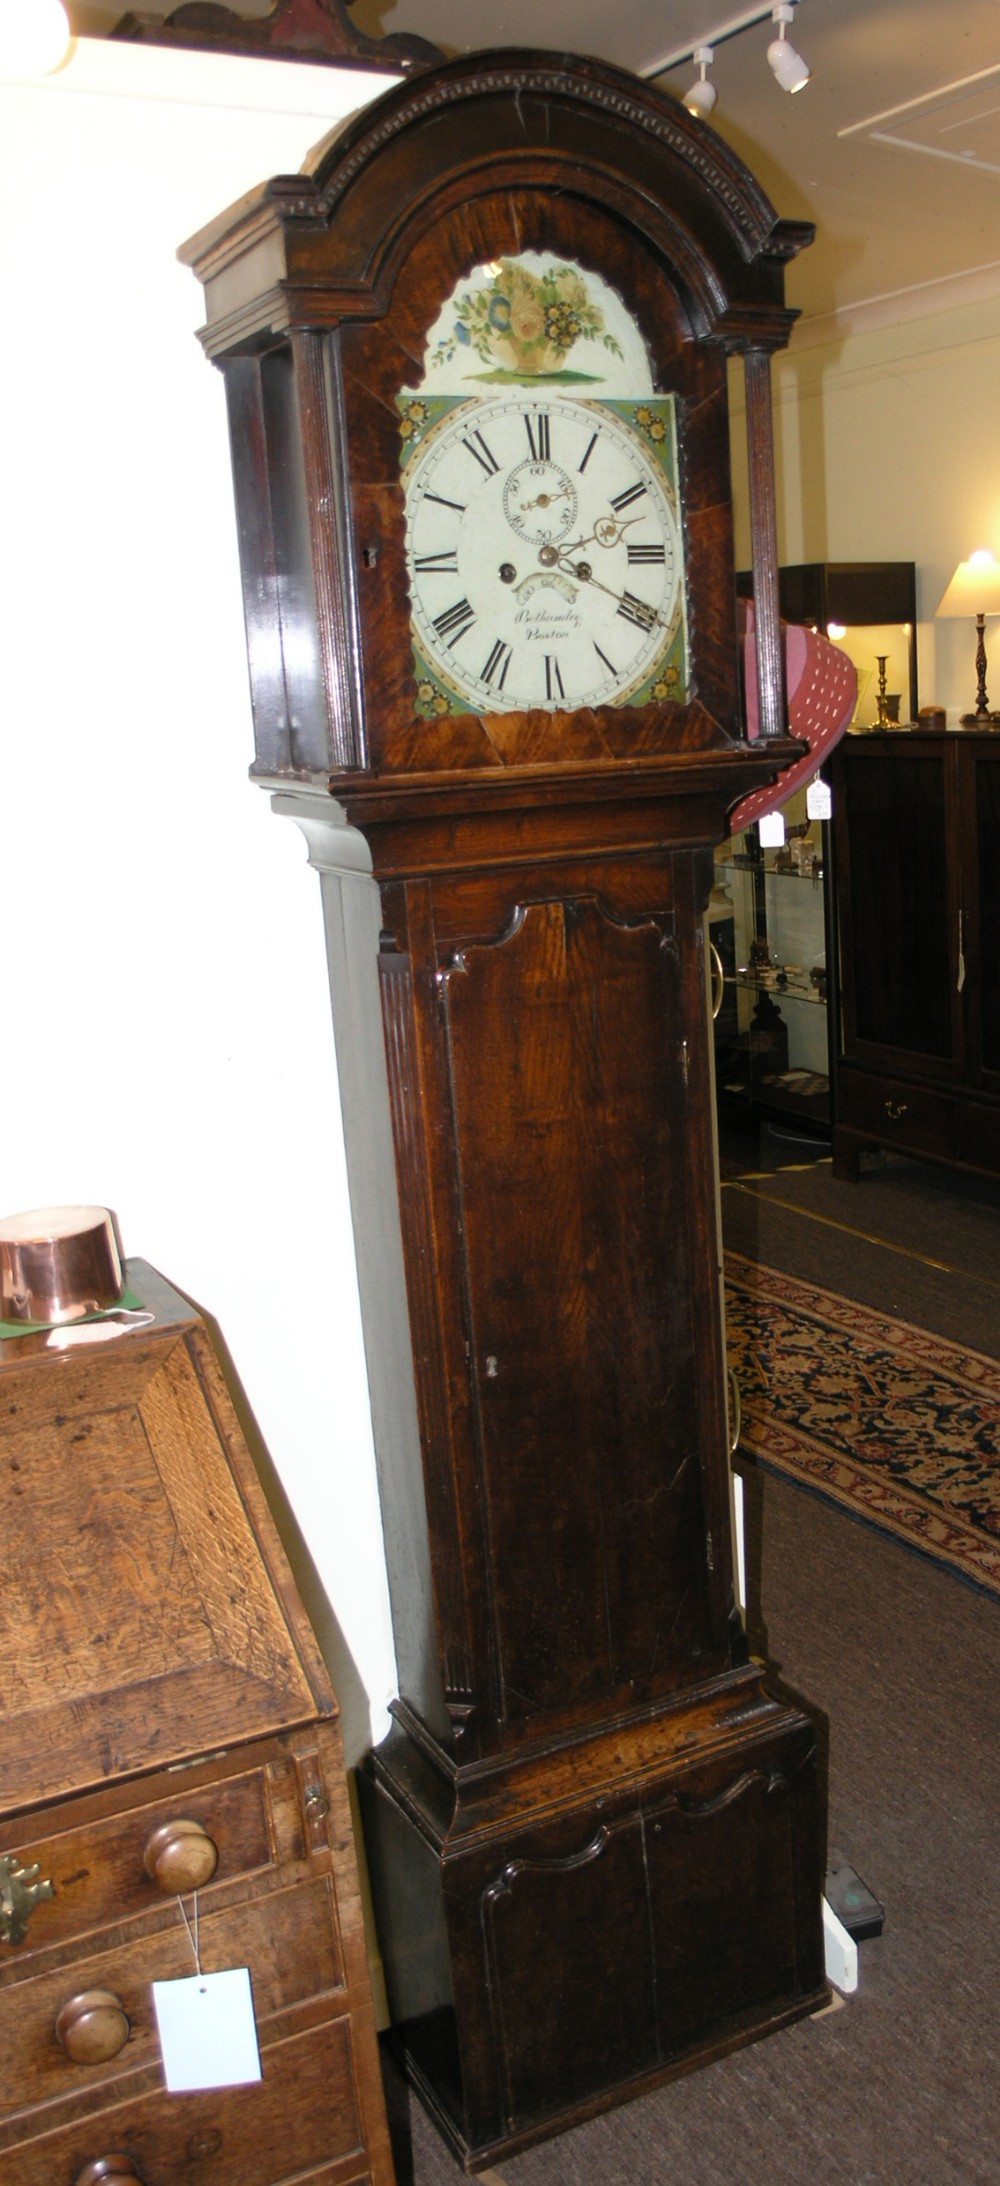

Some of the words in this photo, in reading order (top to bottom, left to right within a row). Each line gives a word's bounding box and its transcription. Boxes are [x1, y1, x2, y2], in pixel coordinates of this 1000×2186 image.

[530, 466, 545, 476] 60
[626, 544, 667, 566] III
[525, 627, 569, 640] Boston
